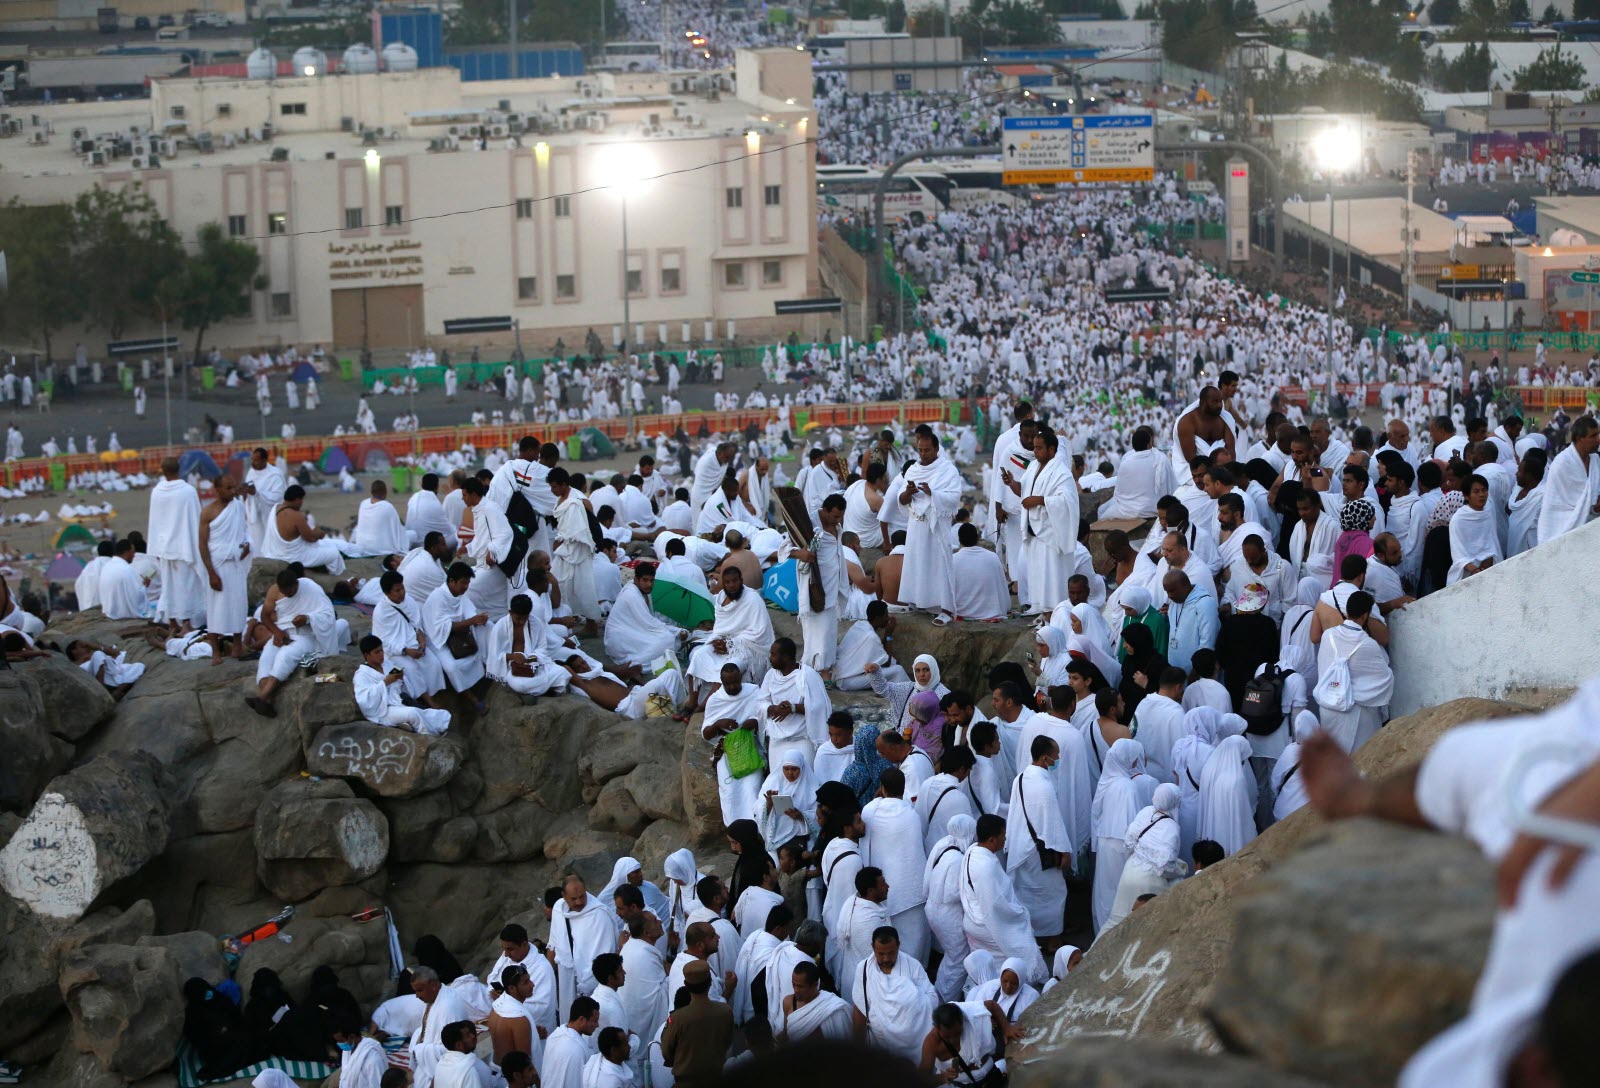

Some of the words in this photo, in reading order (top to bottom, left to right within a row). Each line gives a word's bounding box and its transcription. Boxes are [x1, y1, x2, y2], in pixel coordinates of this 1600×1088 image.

[1040, 119, 1060, 127] ROAD
[386, 239, 422, 253] مستشفى
[389, 255, 422, 266] HOSPITAL
[329, 271, 373, 280] EMERGENCY
